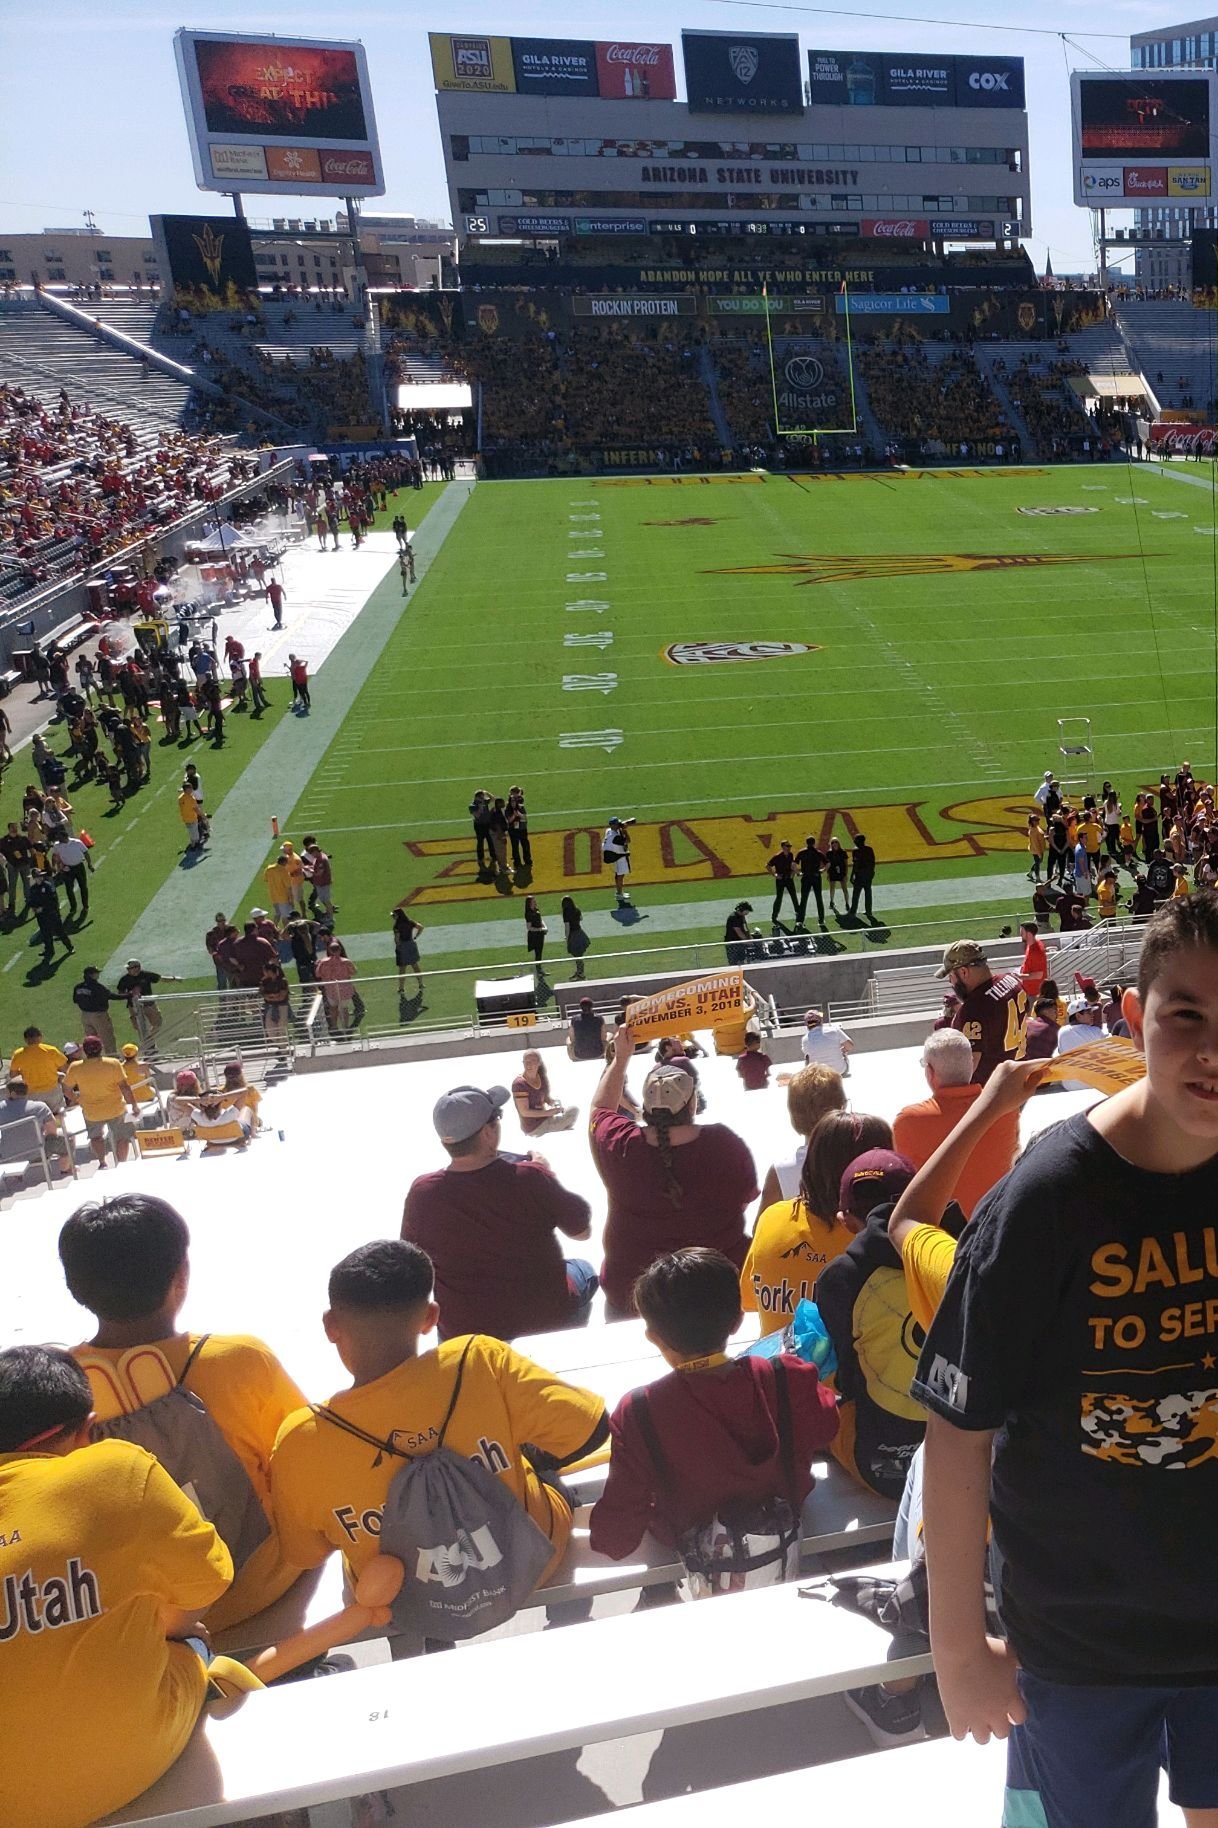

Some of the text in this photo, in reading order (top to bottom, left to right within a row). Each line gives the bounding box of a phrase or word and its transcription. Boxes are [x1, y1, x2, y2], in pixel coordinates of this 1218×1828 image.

[457, 49, 489, 65] ASU
[522, 54, 587, 66] GILA RIVER
[606, 44, 660, 65] Coca-Cola
[457, 64, 490, 77] 2020
[736, 65, 752, 78] 12
[815, 64, 839, 73] POWER
[890, 68, 947, 79] GILA RIVER
[812, 72, 844, 82] THROUGH
[968, 72, 1011, 91] COX
[705, 96, 789, 107] NETWORKS
[325, 158, 369, 175] Coca-Cola
[641, 166, 859, 185] ARIZONA STATE UNIVERSITY
[1098, 177, 1120, 189] aps
[469, 218, 487, 232] 25
[518, 217, 538, 225] COLD
[539, 218, 563, 226] BEERS
[582, 221, 644, 232] enterprise
[690, 224, 696, 234] 0
[873, 221, 915, 236] Coca-Cola
[800, 225, 806, 234] 0
[640, 270, 874, 282] ABANDON HOPE ALL YE WHO ENTER HERE
[634, 300, 678, 315] PROTEIN
[716, 299, 784, 310] YOU DO YOU
[851, 297, 918, 312] Sagicor Life
[780, 392, 837, 408] Allstate
[563, 631, 614, 646] 30
[562, 672, 618, 690] 20
[559, 728, 625, 748] 10
[628, 975, 740, 1015] HOMECOMING
[628, 986, 741, 1023] ASU VS. UTAH
[696, 1006, 707, 1016] 3,
[711, 999, 741, 1013] 2018
[513, 1015, 529, 1026] 19
[962, 1021, 982, 1040] 42
[806, 1253, 827, 1263] SAA
[753, 1273, 796, 1315] Fork
[1087, 1314, 1147, 1351] TO
[407, 1426, 440, 1449] SAA
[334, 1502, 386, 1544] Fo
[415, 1522, 504, 1588] ASU
